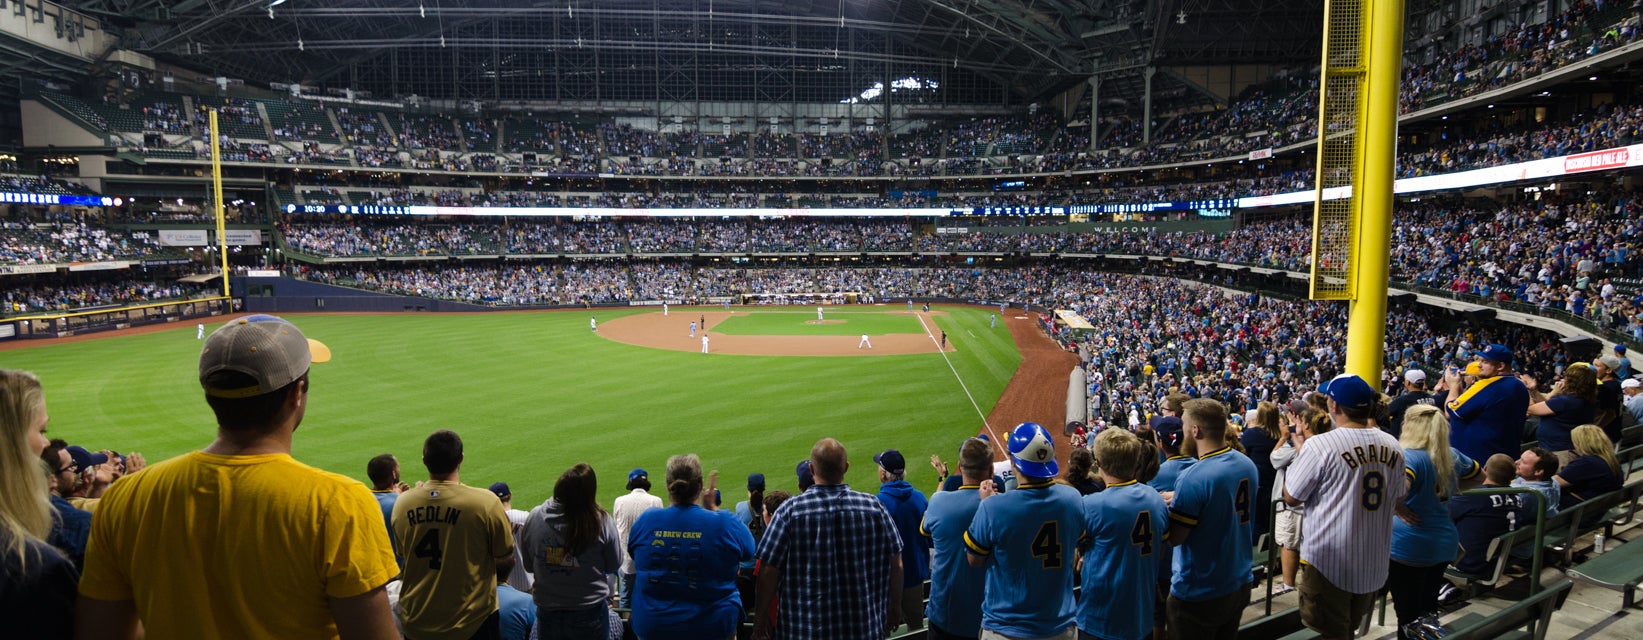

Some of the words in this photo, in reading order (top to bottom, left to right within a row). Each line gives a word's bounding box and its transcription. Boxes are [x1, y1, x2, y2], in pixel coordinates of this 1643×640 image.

[304, 205, 326, 213] 10:20
[1341, 444, 1399, 470] BRAUN
[1235, 478, 1250, 525] 4
[1362, 470, 1384, 512] 8
[407, 505, 462, 527] REDLIN
[663, 530, 682, 538] BREW
[682, 531, 703, 539] CREW
[1131, 510, 1153, 557] 4
[414, 528, 443, 571] 4
[1031, 520, 1062, 569] 4
